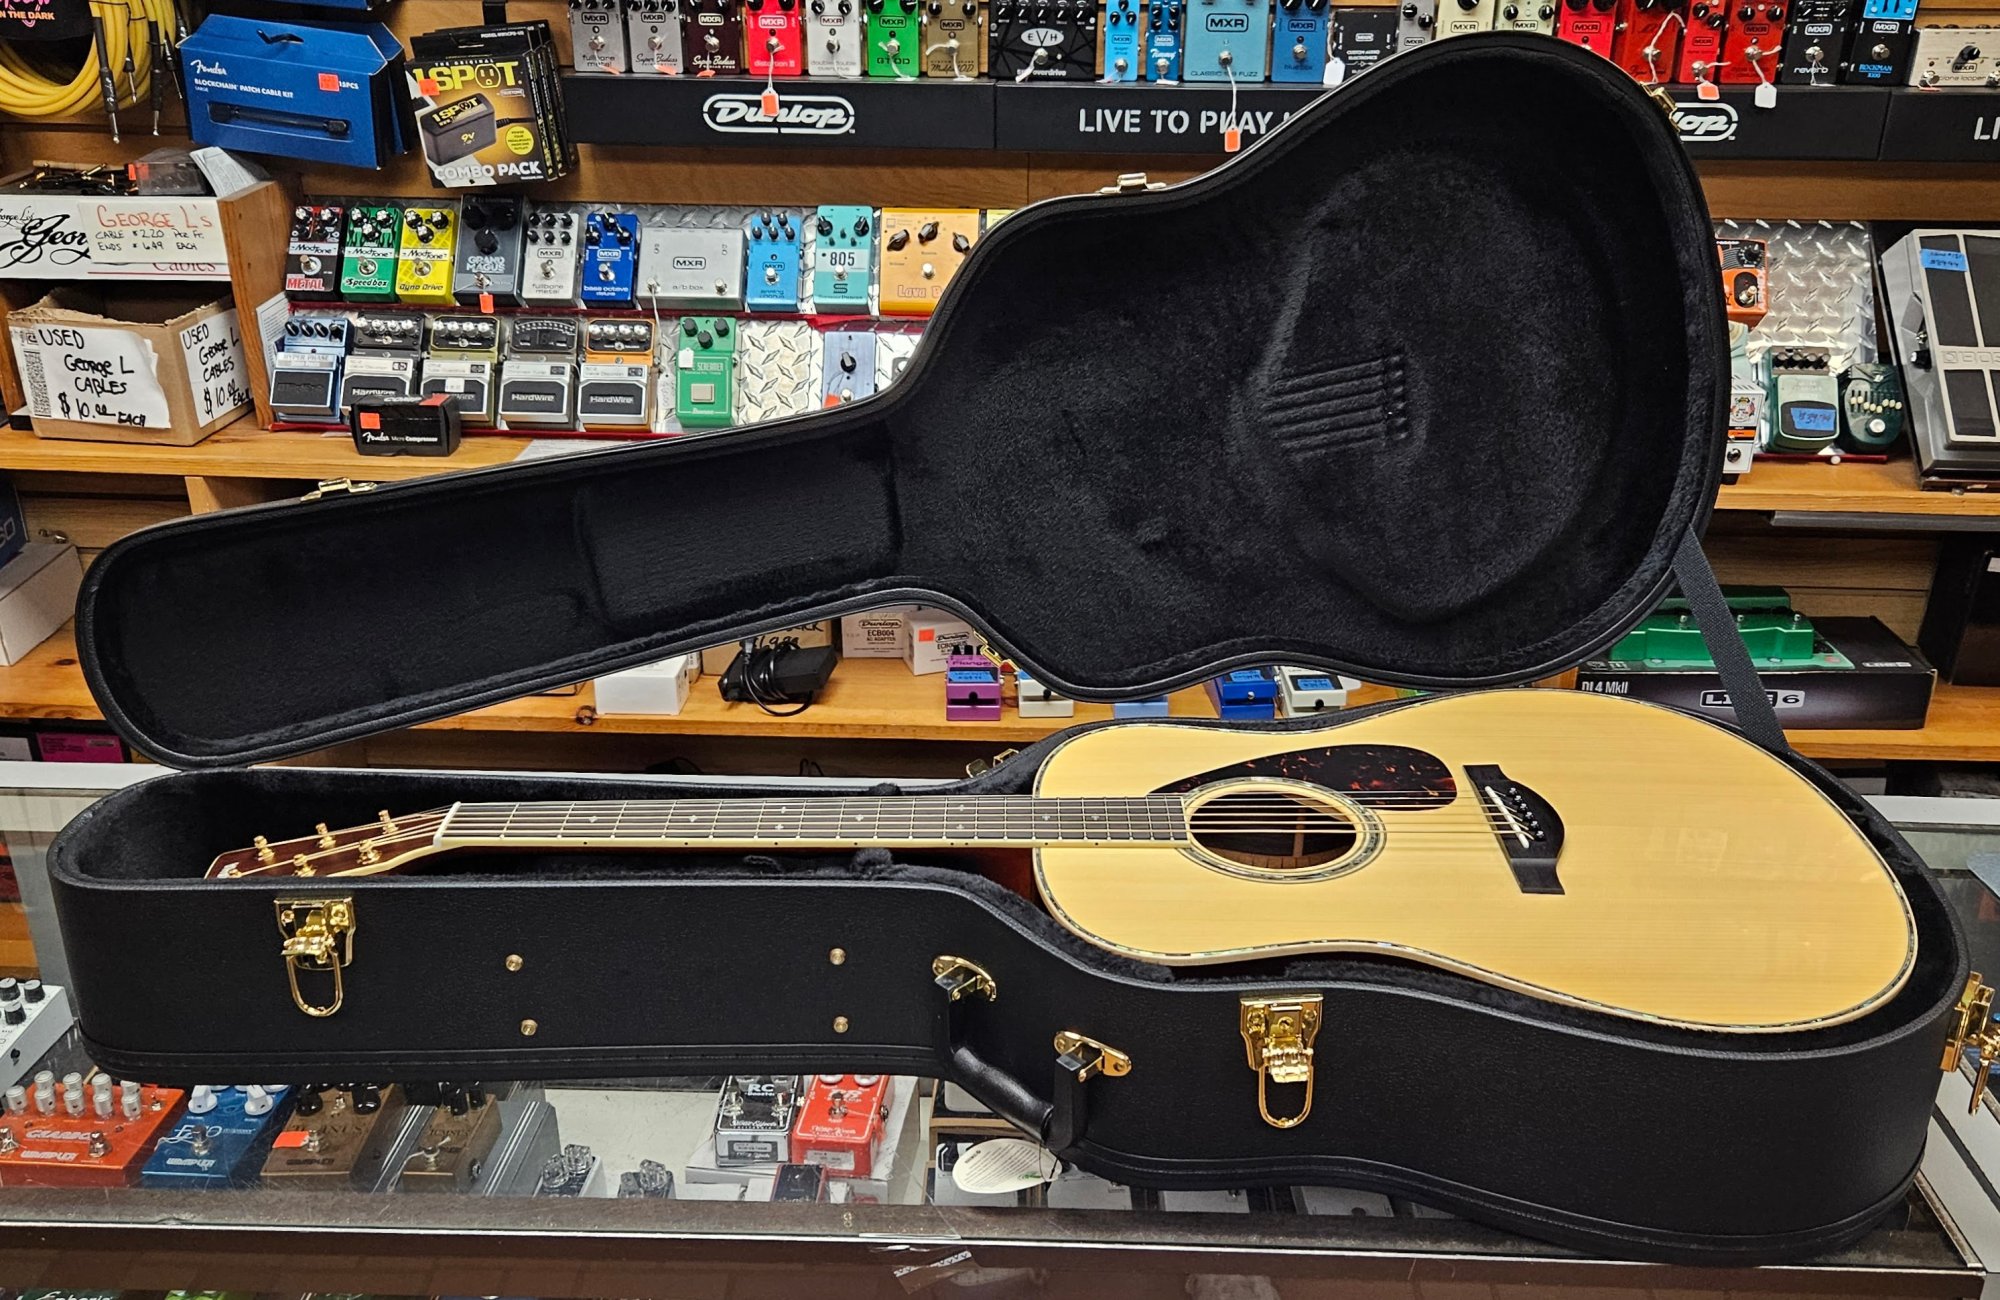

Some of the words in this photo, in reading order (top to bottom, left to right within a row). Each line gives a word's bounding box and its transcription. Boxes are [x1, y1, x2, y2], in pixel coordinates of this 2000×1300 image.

[10, 11, 26, 19] THE
[28, 12, 55, 20] DARK
[762, 18, 784, 26] MXR
[1210, 19, 1245, 28] MXR
[1028, 30, 1057, 46] EVH
[190, 59, 227, 75] Fender
[454, 58, 494, 66] ORIGINAL
[239, 84, 261, 94] PATCH
[262, 87, 281, 97] CABLE
[282, 90, 294, 99] KIT
[1079, 109, 1141, 133] LIVE
[1151, 110, 1190, 134] TO
[461, 131, 475, 143] 9V
[434, 165, 495, 181] COMBO
[498, 161, 542, 177] PACK
[96, 204, 175, 228] GEORGE
[179, 204, 213, 229] L's
[95, 231, 125, 240] CABLE
[97, 242, 122, 251] ENDS
[176, 242, 198, 250] EACH
[468, 256, 505, 264] GRAND
[830, 252, 855, 266] 805
[467, 263, 505, 271] MAGUS
[287, 277, 325, 290] METAL
[897, 285, 926, 298] Lava
[38, 329, 85, 349] USED
[183, 323, 210, 350] USED
[230, 327, 240, 347] L
[120, 355, 134, 375] L
[203, 356, 235, 383] CABLES
[74, 377, 128, 398] CABLES
[512, 394, 555, 402] HardWire
[590, 395, 634, 403] HardWire
[117, 414, 146, 427] EACH
[862, 620, 900, 628] Dunlop
[867, 629, 895, 637] ECB004
[1782, 694, 1800, 704] 6
[748, 1083, 775, 1092] RC
